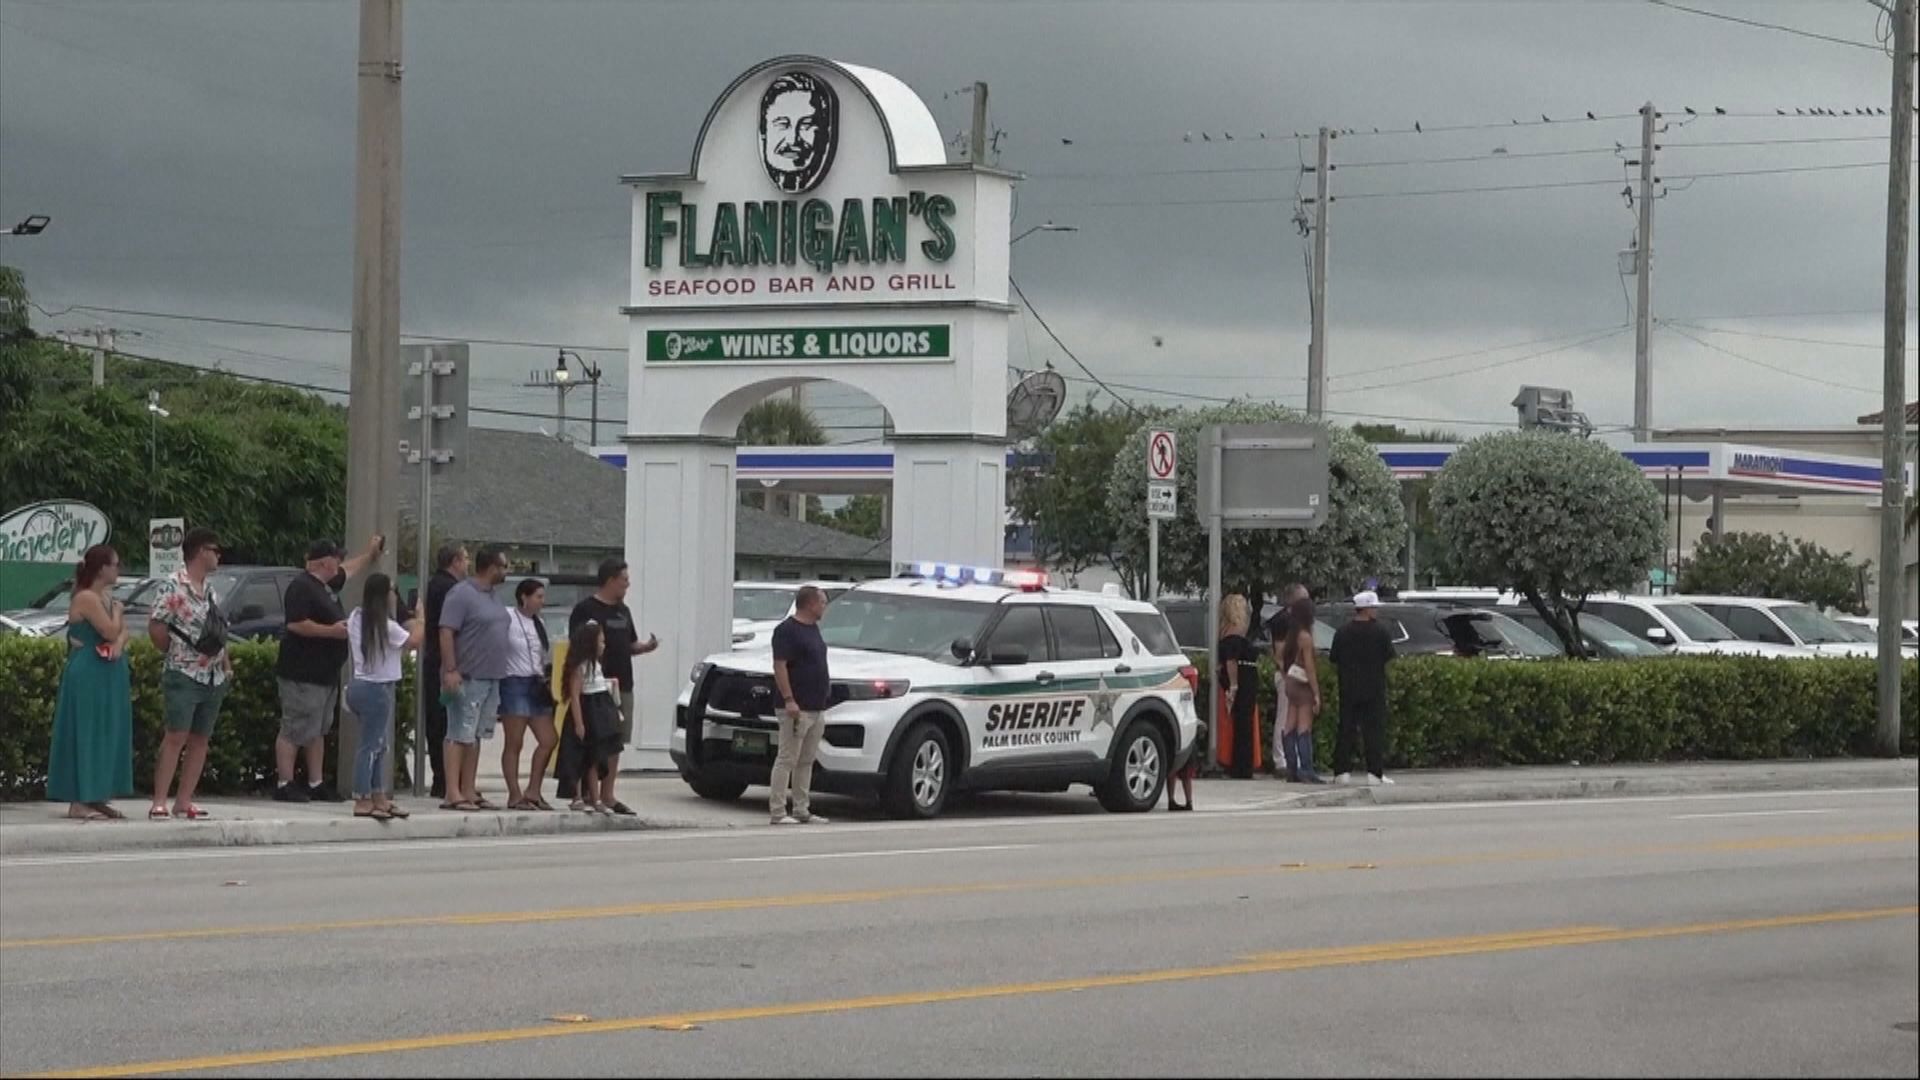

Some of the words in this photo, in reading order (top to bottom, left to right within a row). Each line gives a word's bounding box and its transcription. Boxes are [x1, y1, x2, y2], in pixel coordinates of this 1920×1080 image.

[645, 190, 957, 273] FLANIGAN'S
[648, 278, 757, 297] SEAFOOD
[768, 276, 815, 294] BAR
[826, 275, 876, 293] AND
[888, 273, 956, 291] GRILL
[720, 333, 796, 358] WINES
[802, 333, 821, 356] &
[828, 330, 931, 358] LIQUORS
[1733, 452, 1783, 473] MARATHON
[984, 699, 1086, 733] SHERIFF
[982, 735, 1010, 749] PALM
[1011, 732, 1042, 747] BEACH
[1043, 729, 1081, 744] COUNTY
